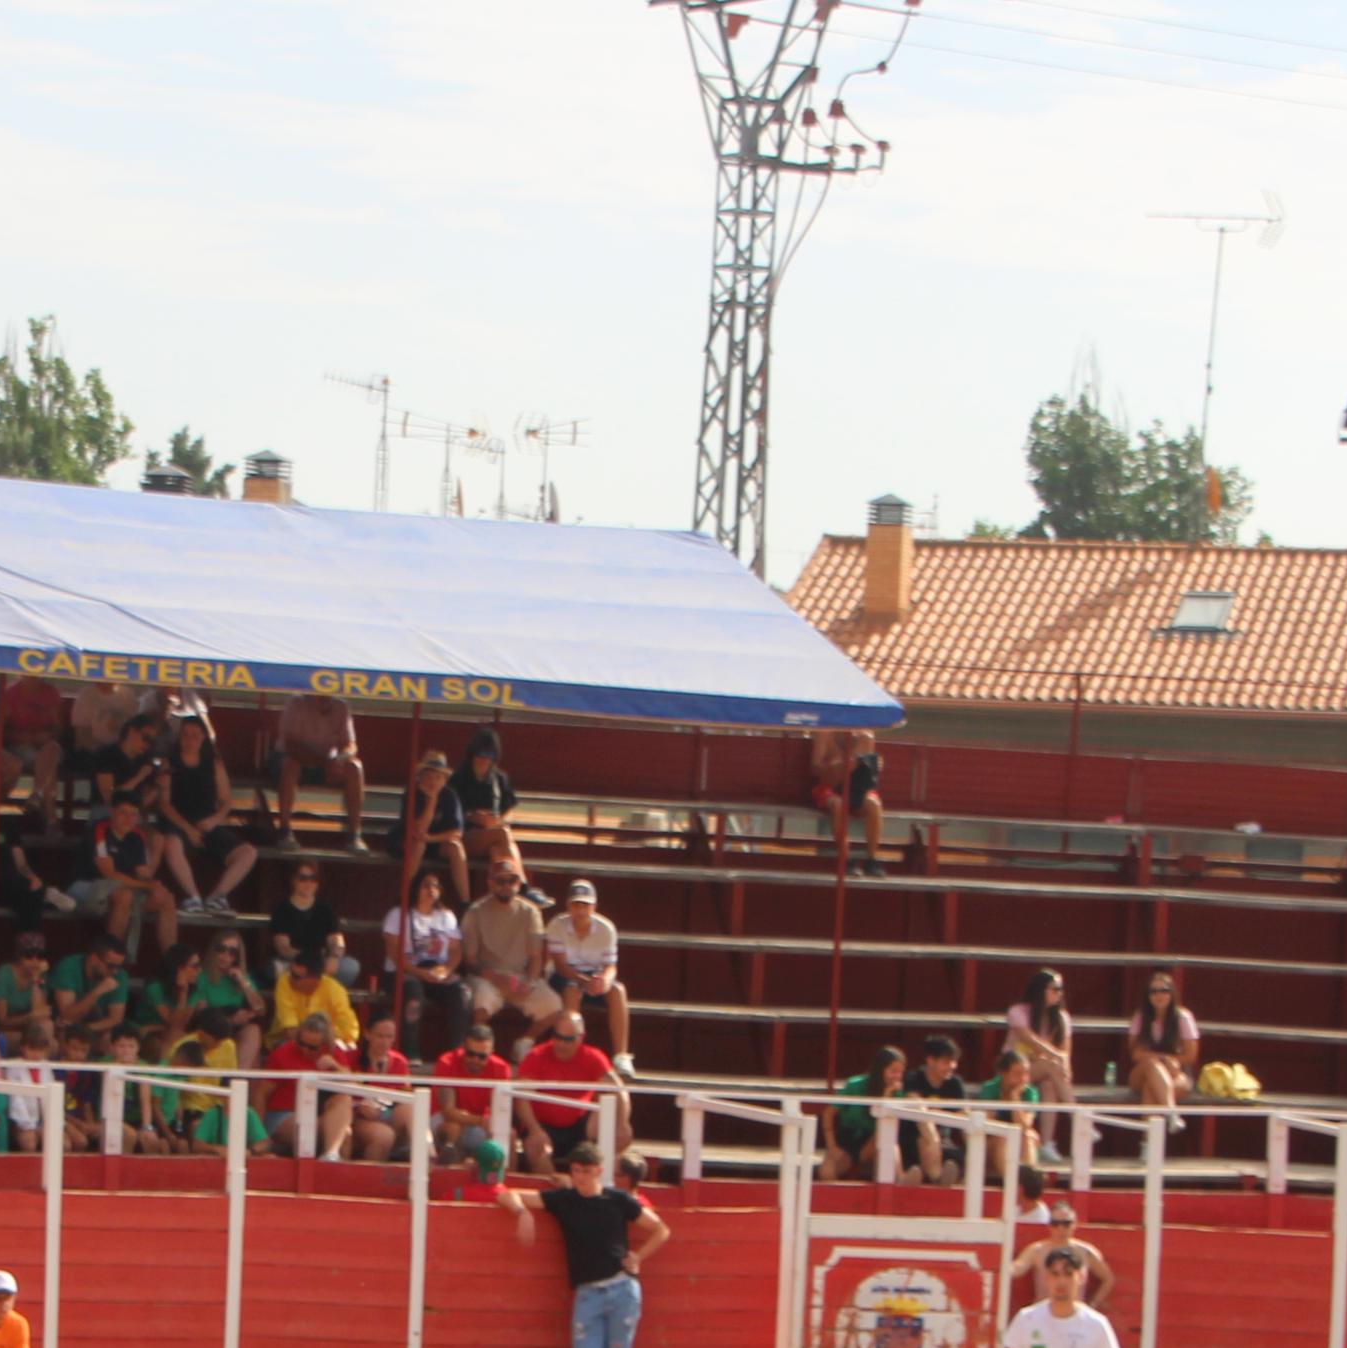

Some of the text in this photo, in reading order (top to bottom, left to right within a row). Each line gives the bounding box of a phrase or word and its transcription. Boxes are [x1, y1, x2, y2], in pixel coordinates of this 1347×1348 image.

[18, 649, 525, 708] CAFETERIA GRAN SOL
